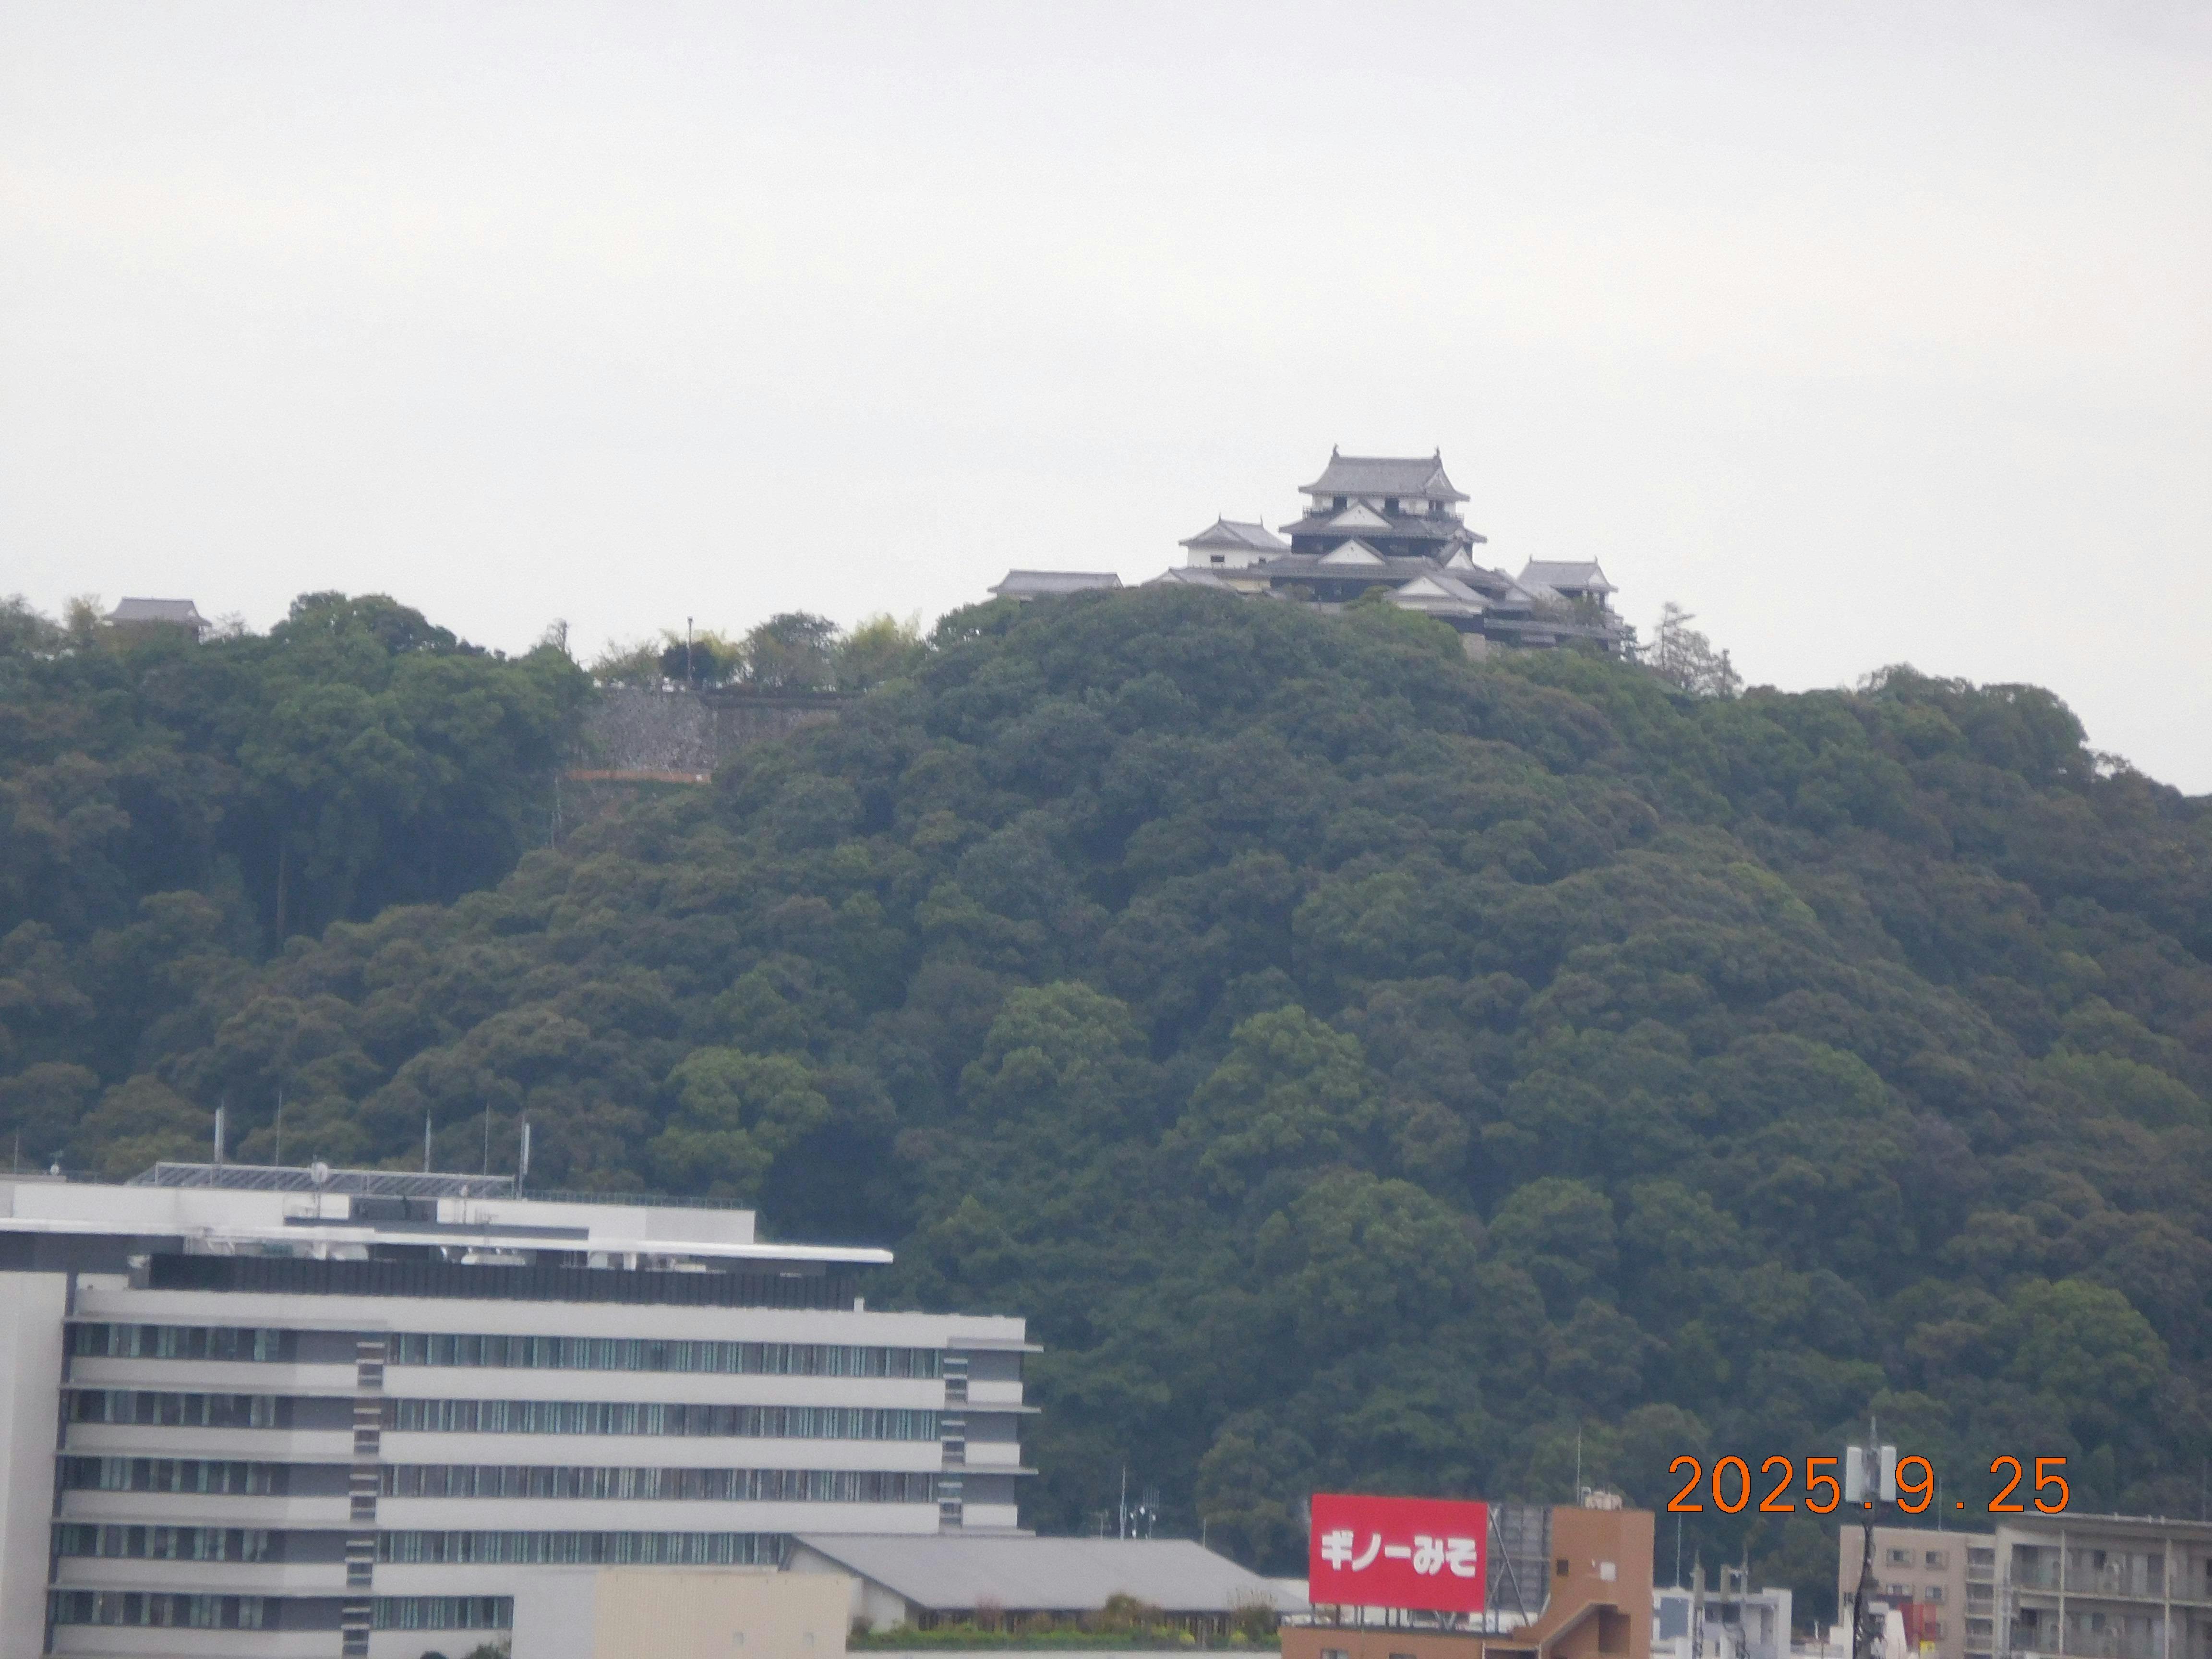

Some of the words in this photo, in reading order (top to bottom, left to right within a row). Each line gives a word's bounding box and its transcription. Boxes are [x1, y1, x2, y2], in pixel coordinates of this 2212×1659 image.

[1321, 1529, 1477, 1578] ギノーみそ
